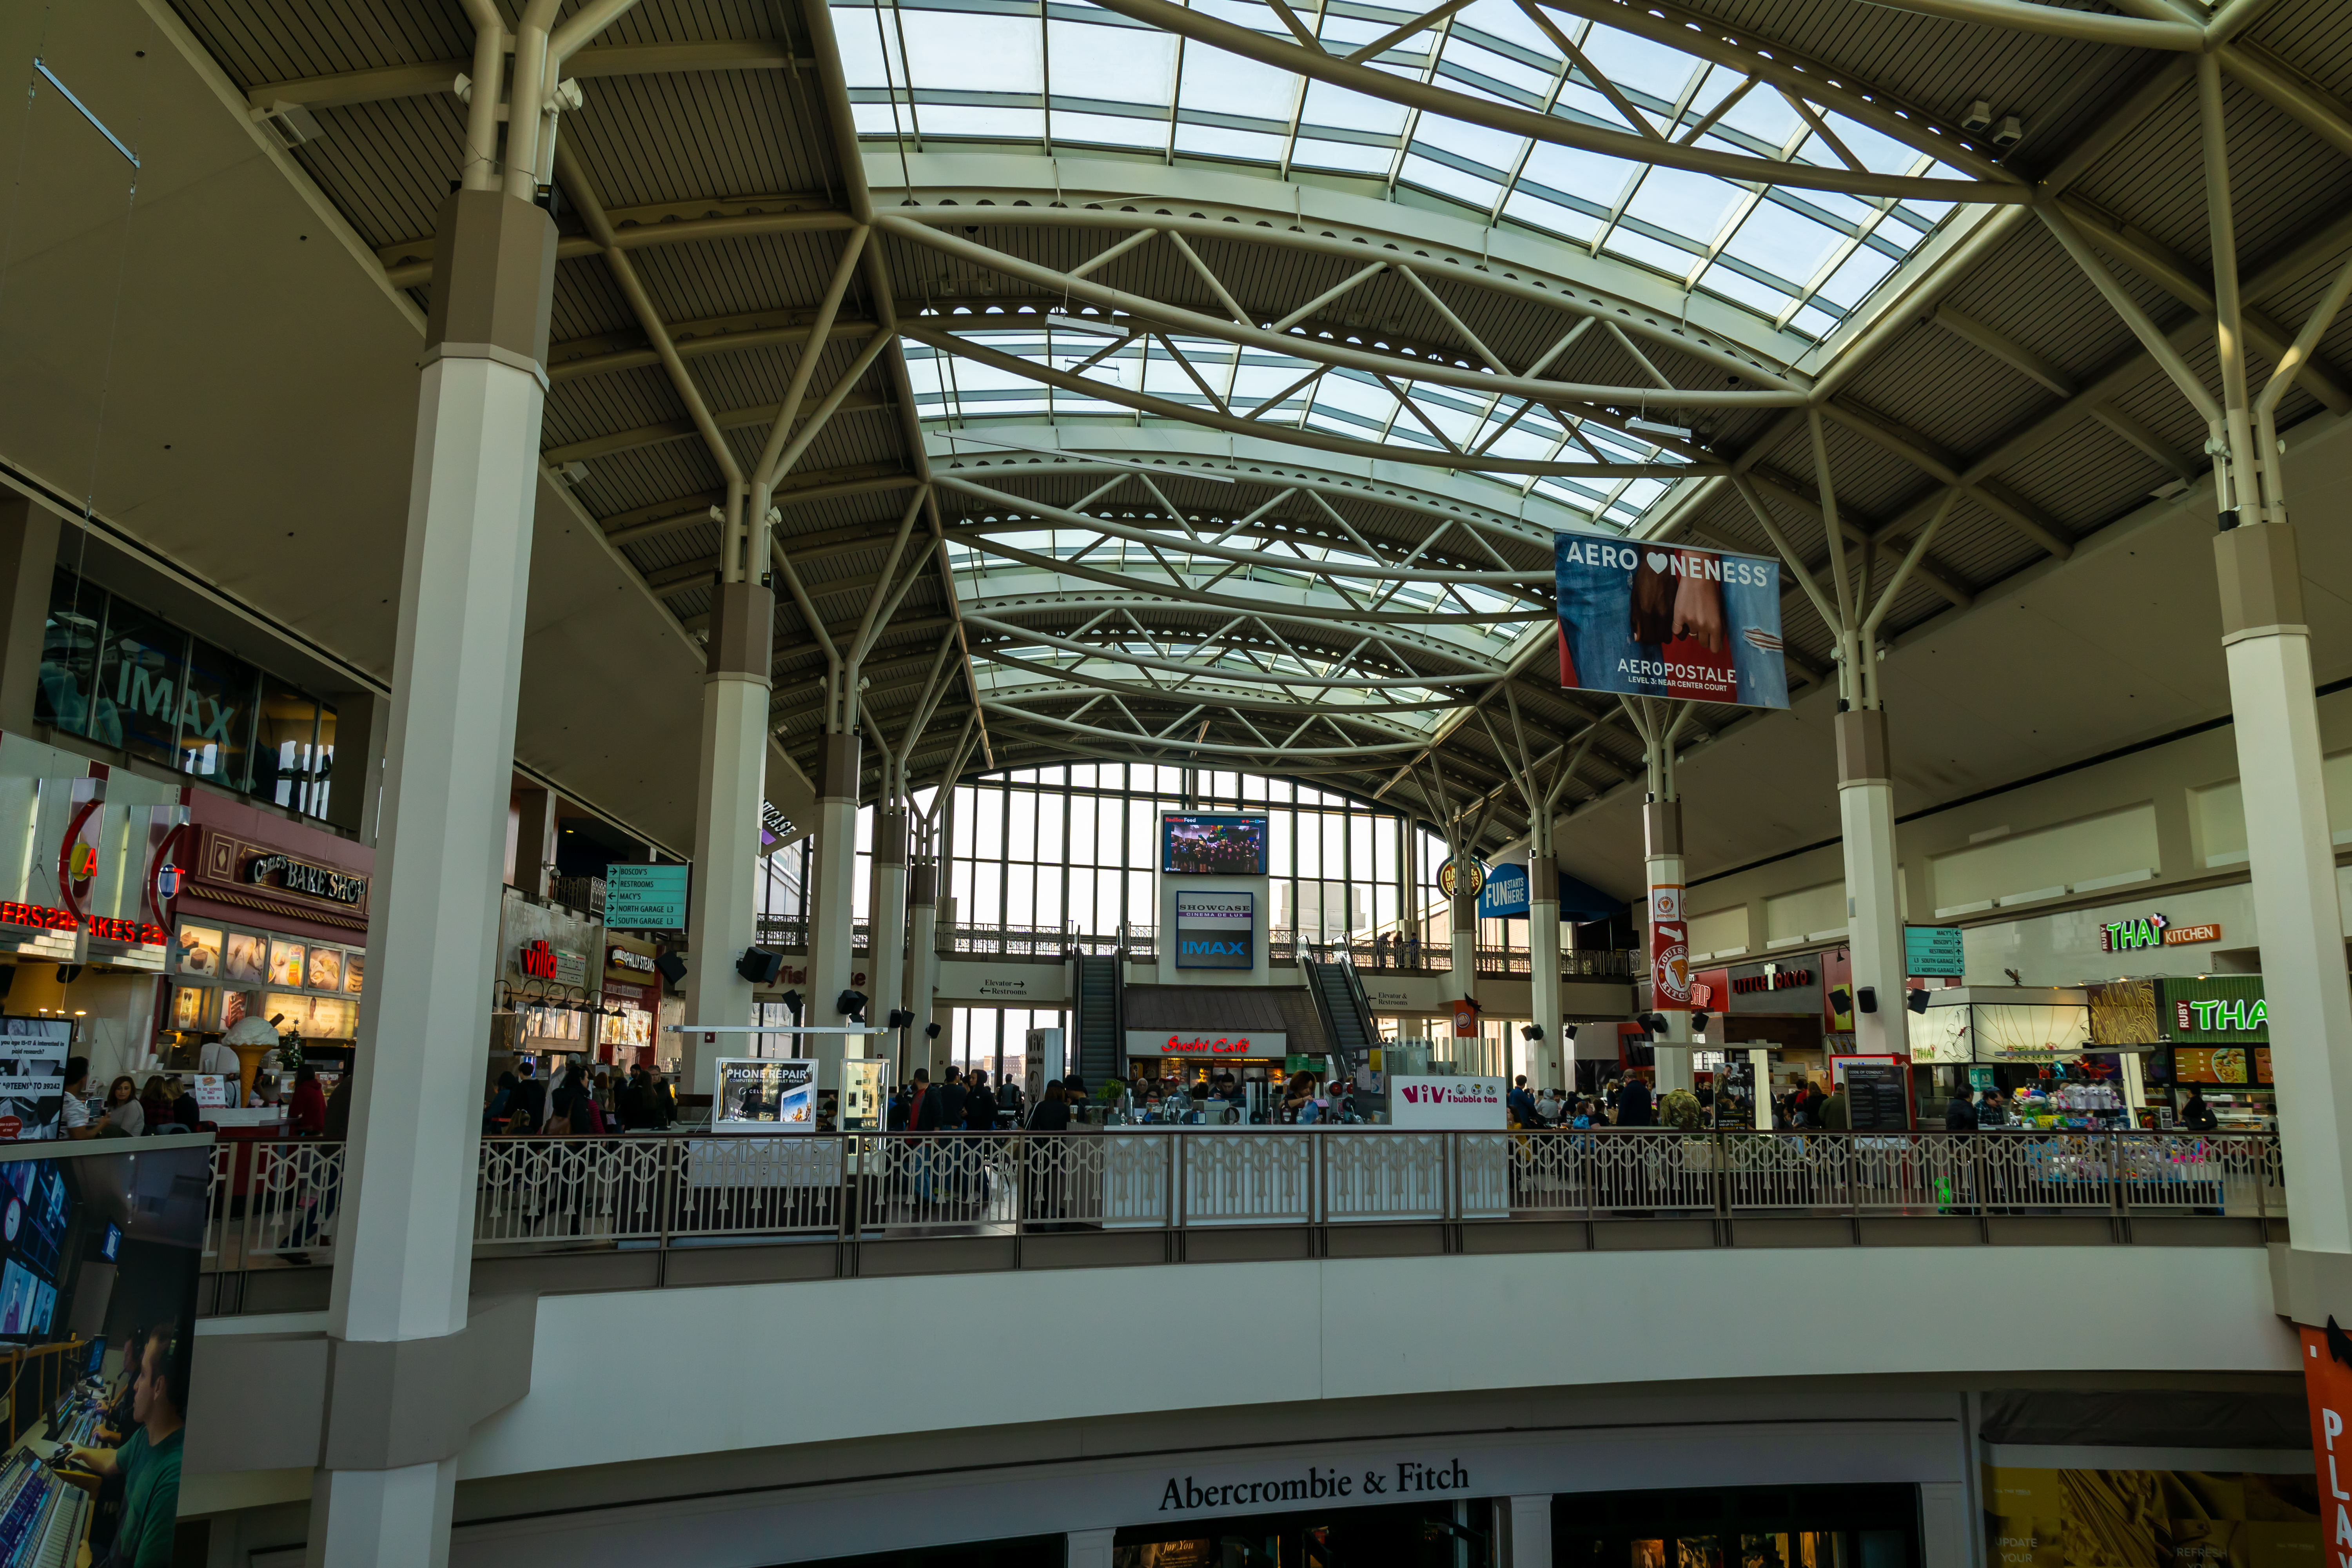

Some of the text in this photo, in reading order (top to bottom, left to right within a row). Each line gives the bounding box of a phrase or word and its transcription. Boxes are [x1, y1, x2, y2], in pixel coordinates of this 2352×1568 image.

[1566, 541, 1638, 570] AERO
[1617, 658, 1737, 683] AEROPOSTALE
[1628, 676, 1649, 684] LEVEL
[1677, 681, 1703, 689] CENTER
[1704, 683, 1727, 691] COURT
[117, 659, 234, 747] IMAX
[287, 862, 327, 895] BAKE
[328, 873, 366, 904] SHOP
[1486, 877, 1524, 908] FUN STARTS
[1508, 888, 1524, 904] HERE
[0, 902, 43, 927] ERS
[2107, 918, 2160, 950] THAI
[2165, 926, 2213, 943] KITCHEN
[525, 940, 557, 979] villa
[1182, 941, 1245, 955] IMAX
[626, 952, 640, 968] PHILLY
[640, 955, 655, 973] STEAKS
[1732, 963, 1808, 993] LITTLE TOKYO
[1691, 984, 1711, 1007] SHOP
[2177, 999, 2269, 1030] RUBY THA
[1161, 1035, 1209, 1052] Sushi
[727, 1069, 806, 1079] PHONE REPAIR
[1158, 1458, 1469, 1510] Abercrombie & Fitch
[1162, 1540, 1194, 1555] for You
[1995, 1537, 2037, 1548] UPDATE
[2177, 1547, 2228, 1557] REFRESH
[2000, 1553, 2032, 1563] YOUR
